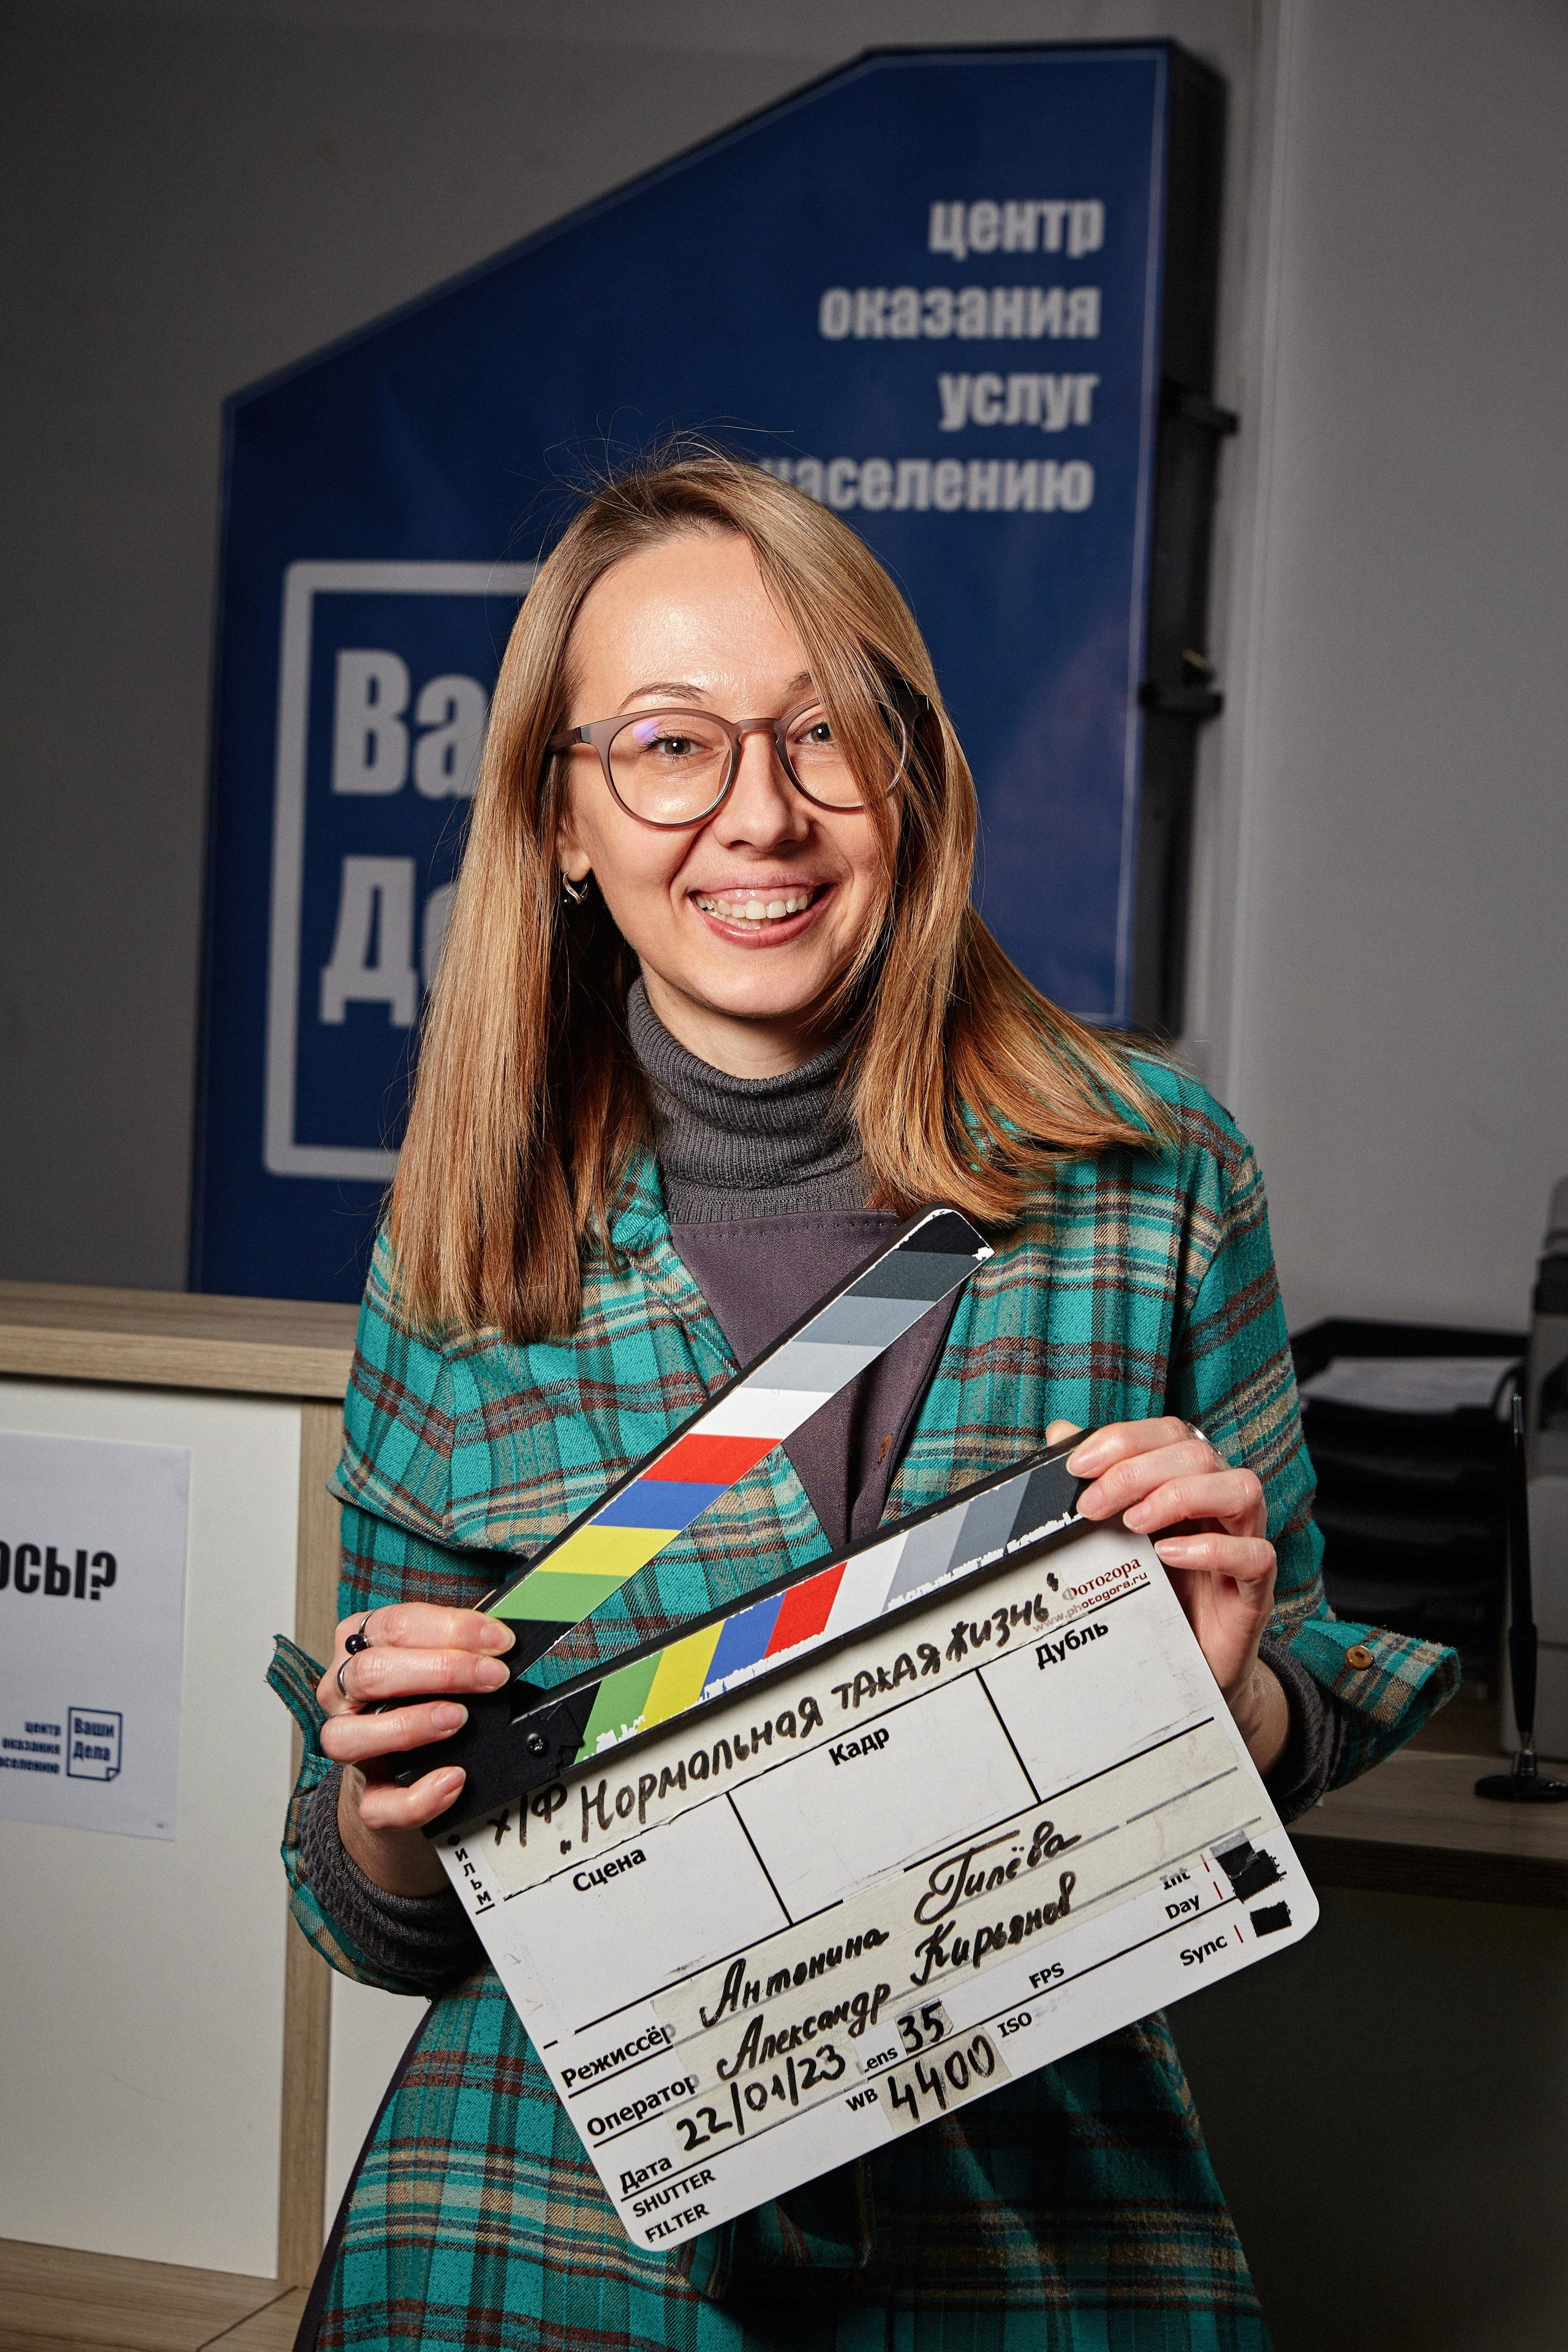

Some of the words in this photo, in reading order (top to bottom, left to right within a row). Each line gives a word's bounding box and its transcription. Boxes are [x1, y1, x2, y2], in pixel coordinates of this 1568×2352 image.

[929, 200, 1104, 261] центр
[819, 287, 1101, 340] оказания
[938, 373, 1098, 431] услуг
[1033, 1572, 1148, 1632] www.photogora.ru
[1062, 1559, 1142, 1600] Фотогора
[1035, 1623, 1109, 1670] Дубль
[74, 1717, 115, 1738] Ваши
[74, 1740, 110, 1761] Дела
[829, 1727, 889, 1765] Кадр
[573, 1849, 647, 1891] Сцена
[699, 1928, 889, 2027] Антонина
[914, 1820, 1082, 1925] Гилёва
[1165, 1894, 1199, 1920] Day
[1180, 1936, 1227, 1966] Sync
[717, 1984, 891, 2081] Александр
[910, 1871, 1076, 1986] Кирьянов
[1029, 1962, 1065, 1988] FPS
[897, 2000, 944, 2052] 35
[997, 2012, 1032, 2038] ISO
[561, 2024, 676, 2087] Режиссёр
[888, 2035, 995, 2122] 4400
[587, 2074, 699, 2136] Оператор
[676, 2044, 846, 2150] 22/01/23
[846, 2089, 878, 2111] WB
[619, 2157, 673, 2194] Дата
[632, 2169, 717, 2217] SHUTTER
[645, 2204, 710, 2243] FILTER
